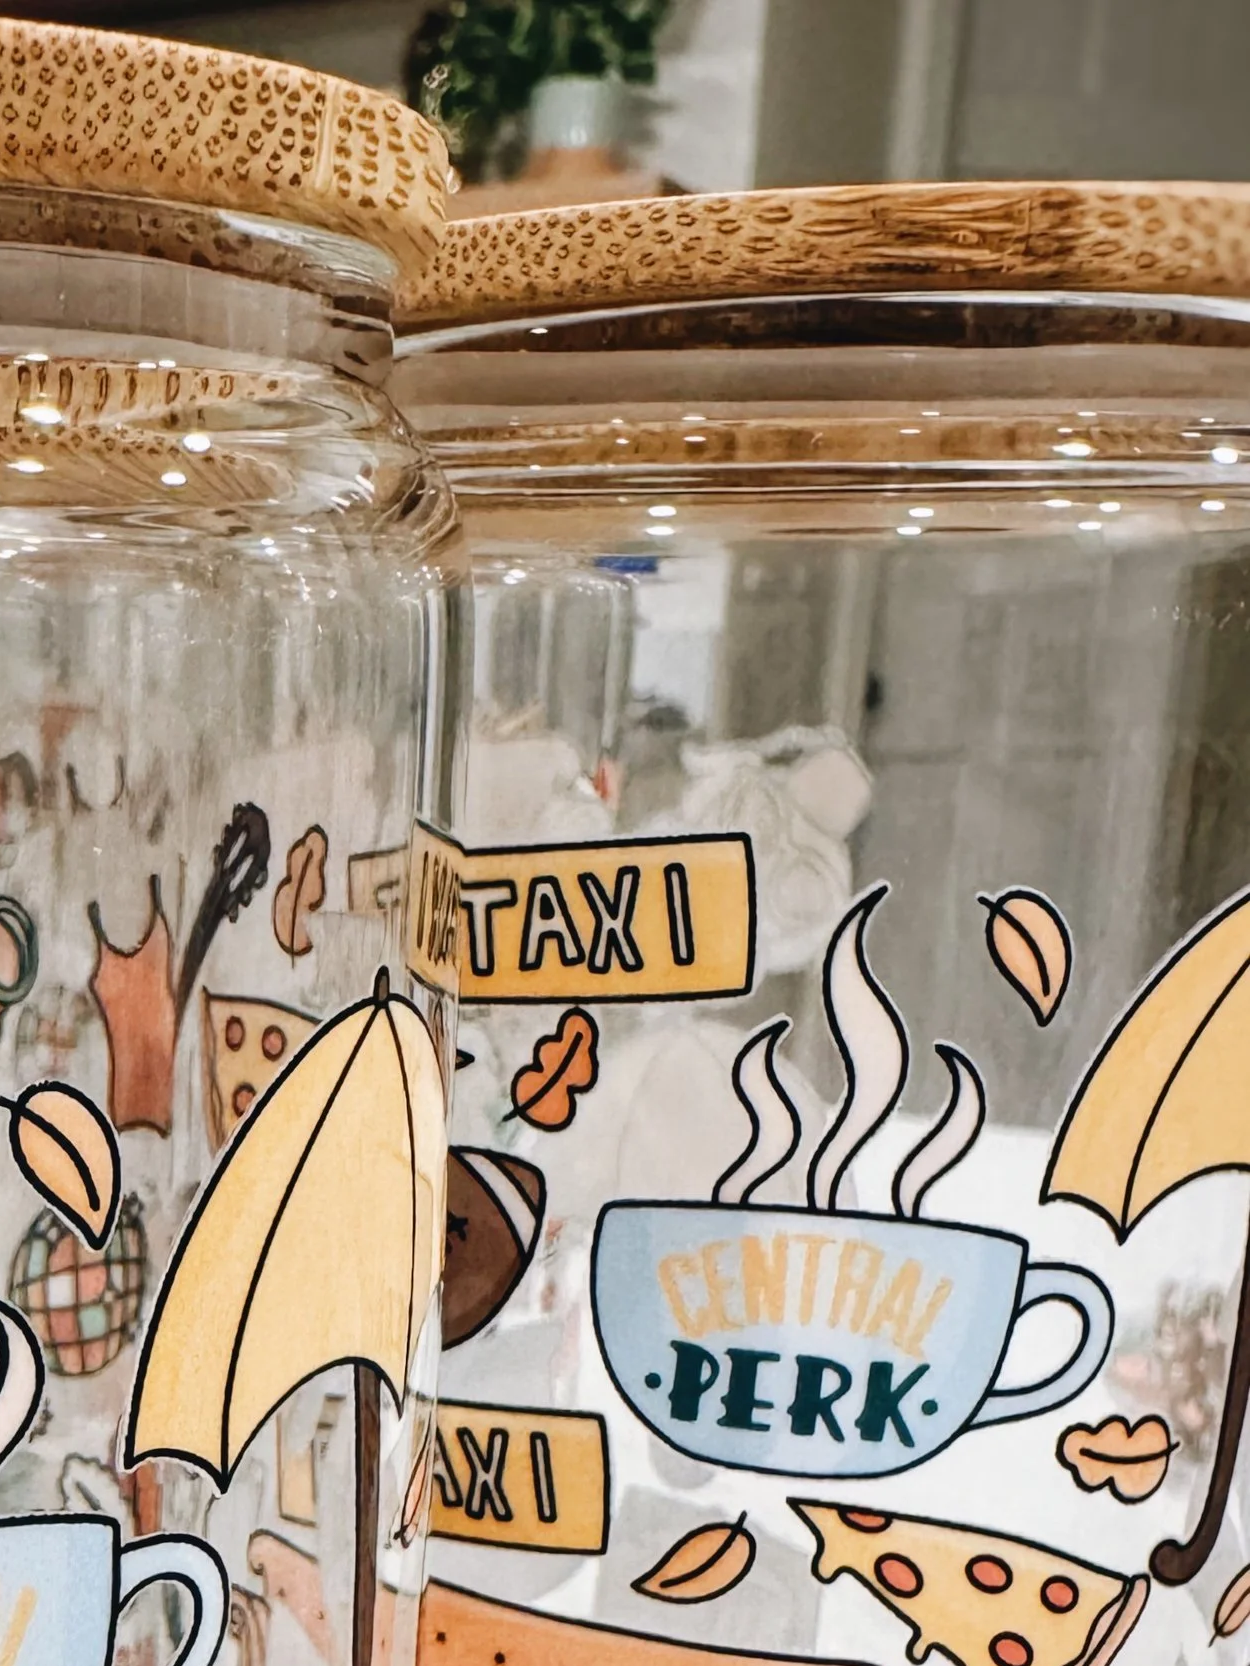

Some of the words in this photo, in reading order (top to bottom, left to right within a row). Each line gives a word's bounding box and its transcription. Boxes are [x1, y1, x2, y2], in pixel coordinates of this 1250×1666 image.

[458, 861, 696, 977] TAXI
[656, 1231, 954, 1361] CENTRAL
[433, 1427, 558, 1523] AXI
